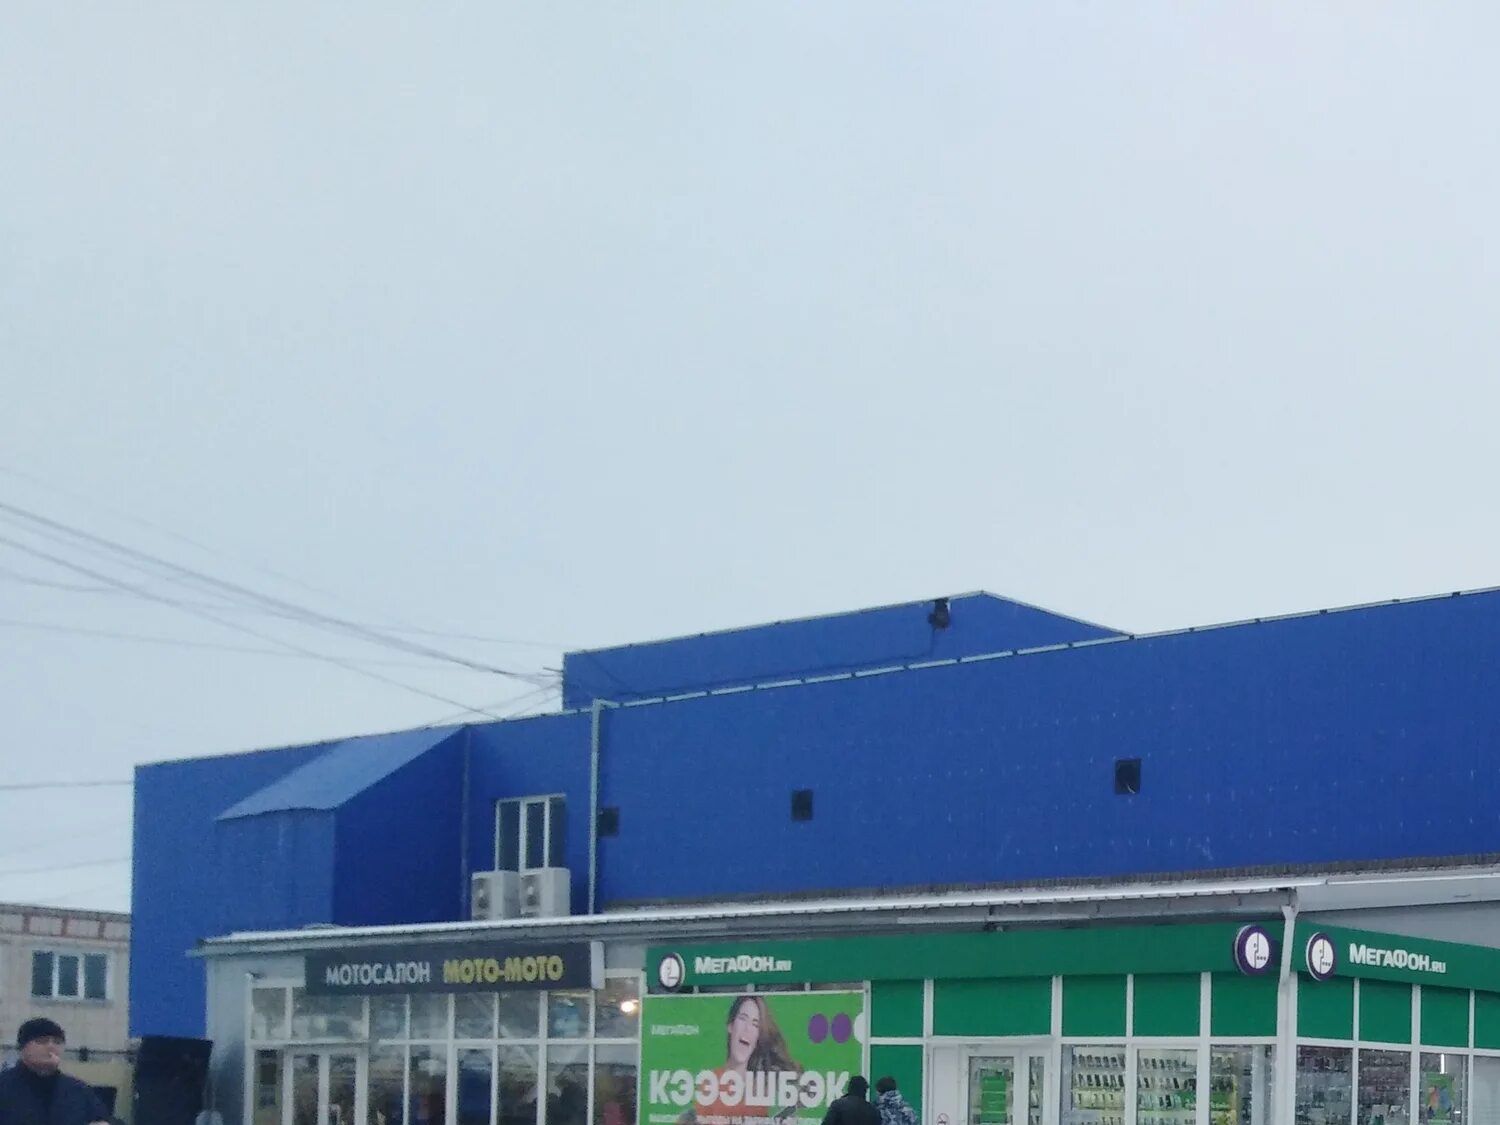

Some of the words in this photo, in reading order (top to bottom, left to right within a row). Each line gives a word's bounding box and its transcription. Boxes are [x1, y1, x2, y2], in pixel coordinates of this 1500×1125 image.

[325, 962, 430, 985] МОТОСАЛОН
[443, 955, 564, 983] МОТО-МОТО
[650, 1069, 850, 1109] КЭЭЭШБЭК
